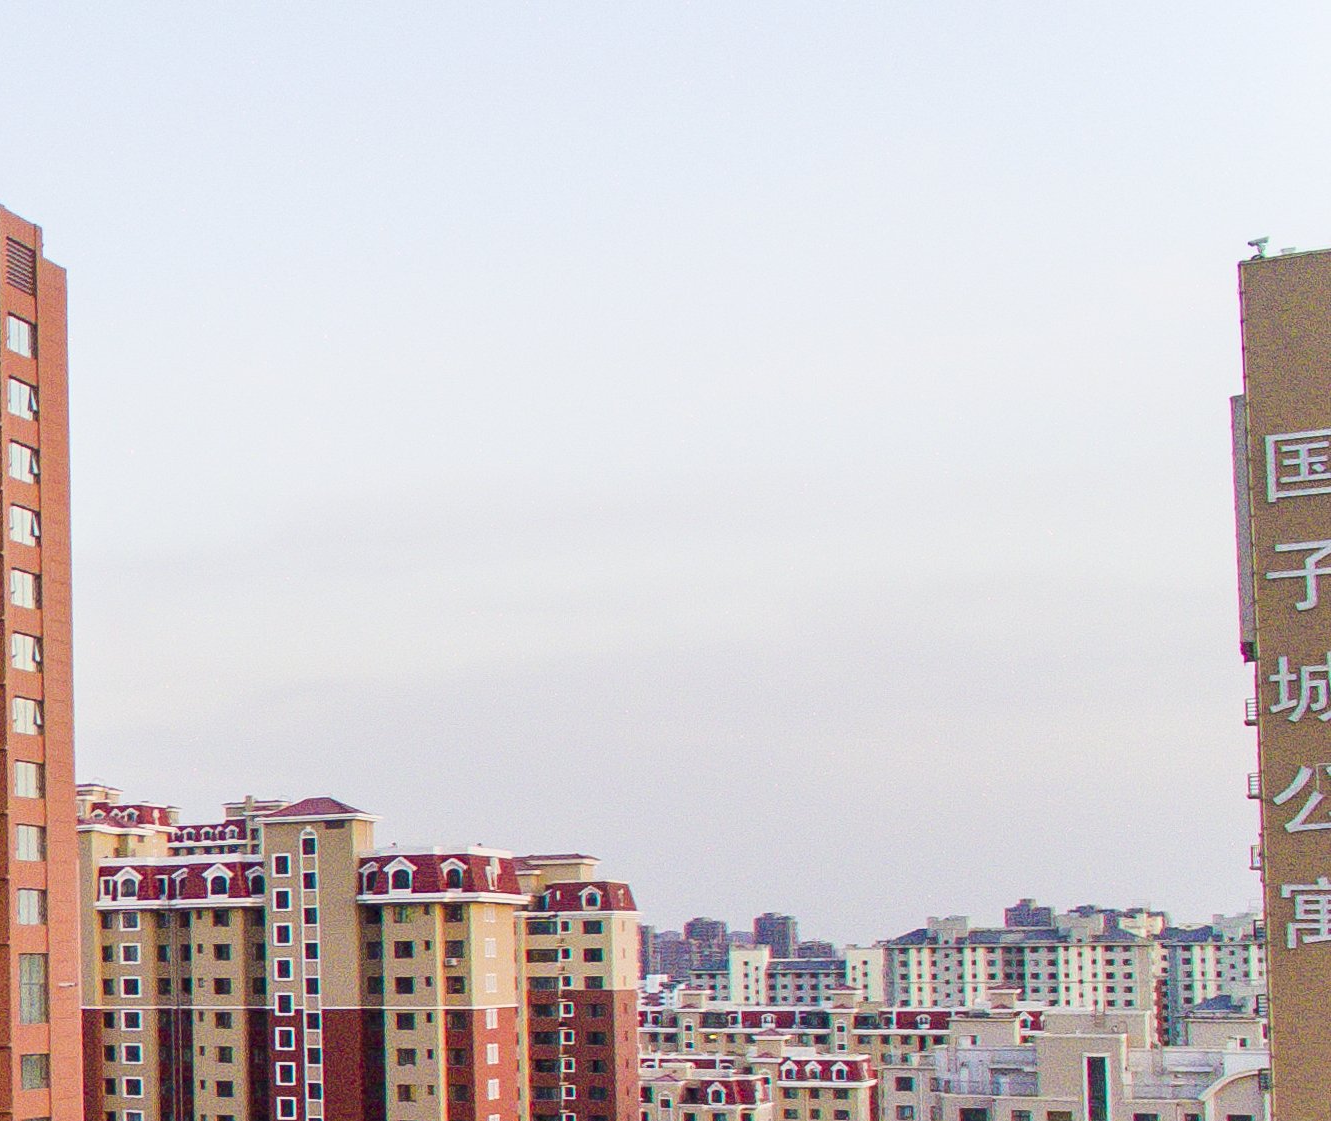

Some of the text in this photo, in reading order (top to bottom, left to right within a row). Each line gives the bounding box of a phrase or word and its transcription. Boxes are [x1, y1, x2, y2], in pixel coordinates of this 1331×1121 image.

[1265, 428, 1331, 950] 国子城公寓
